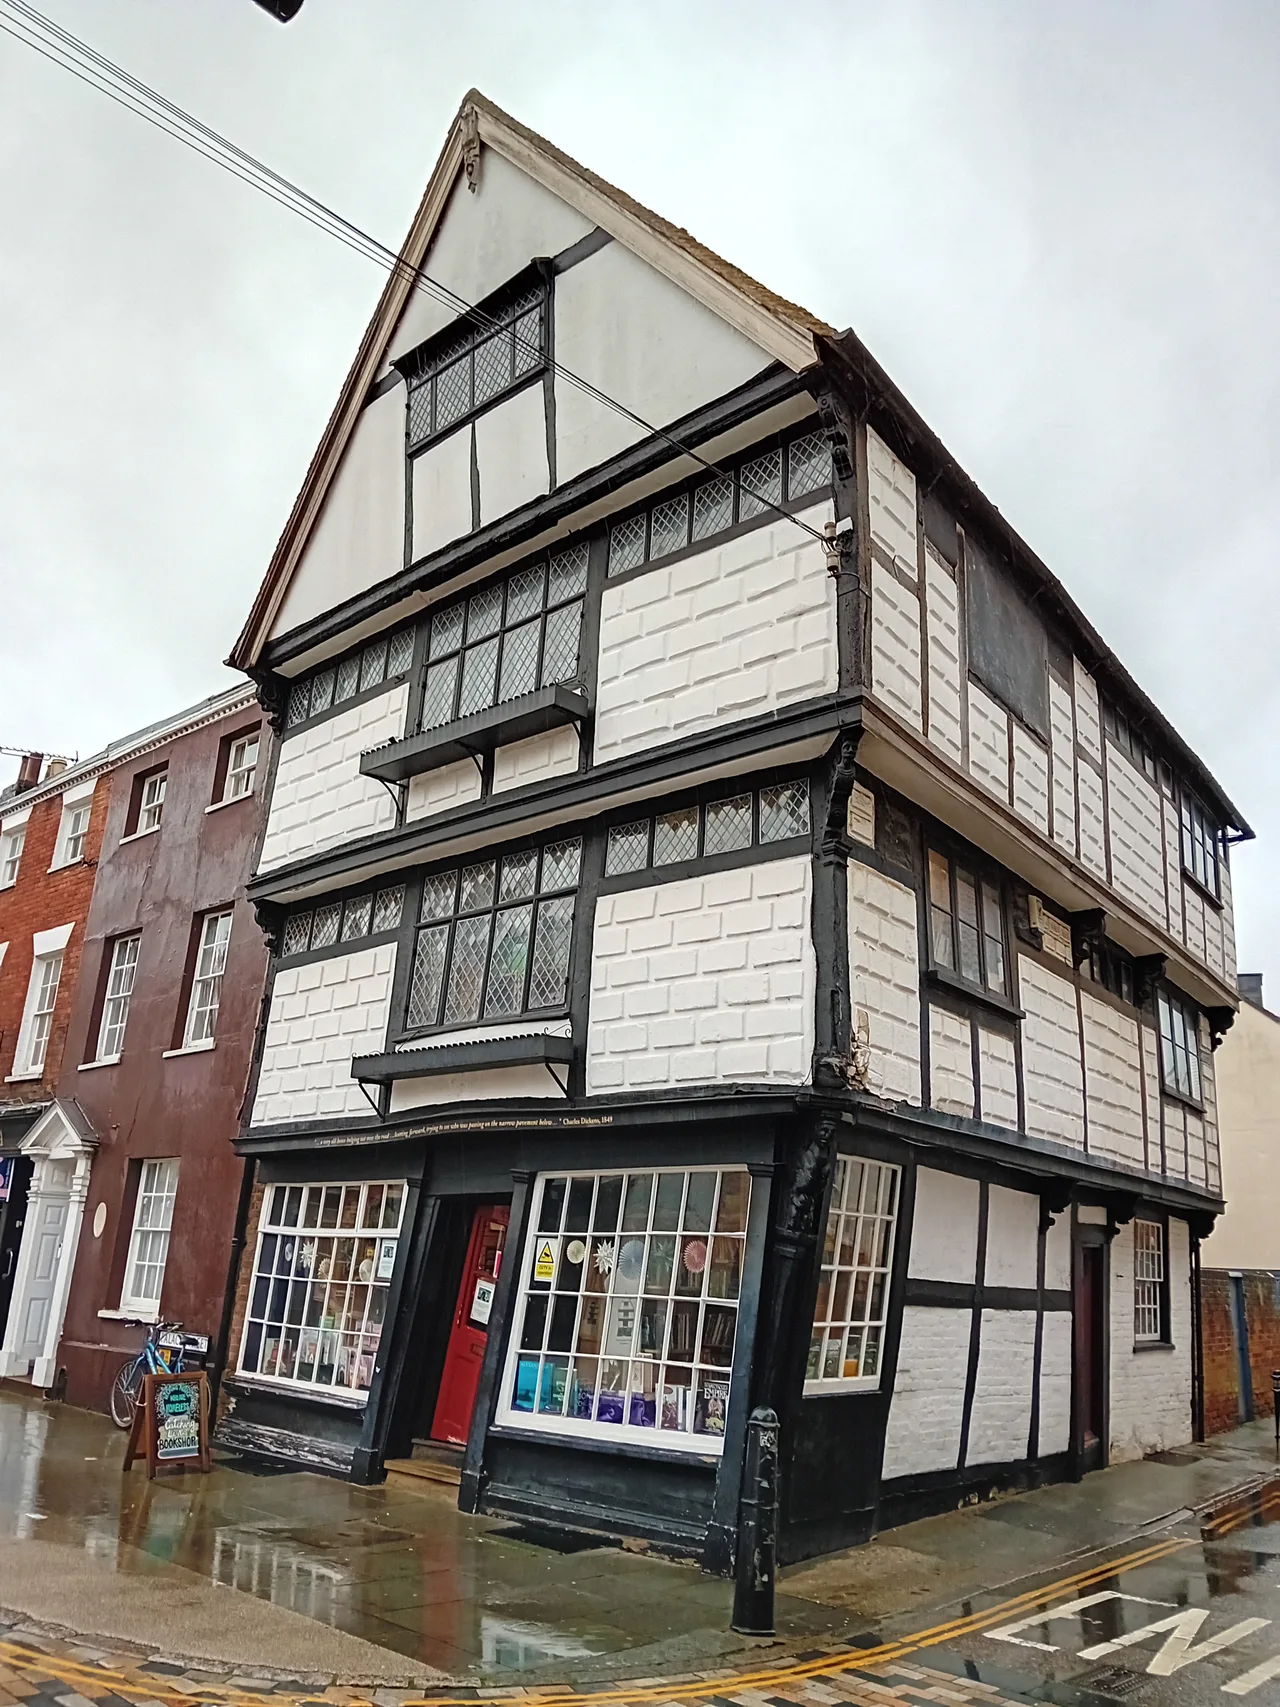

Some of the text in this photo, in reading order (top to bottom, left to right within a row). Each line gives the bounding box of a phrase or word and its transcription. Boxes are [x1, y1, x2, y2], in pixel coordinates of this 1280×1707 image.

[426, 1125, 438, 1134] trying
[515, 1120, 538, 1128] pavement
[581, 1117, 601, 1125] Dickens,
[160, 1436, 196, 1450] BOOKSHOP
